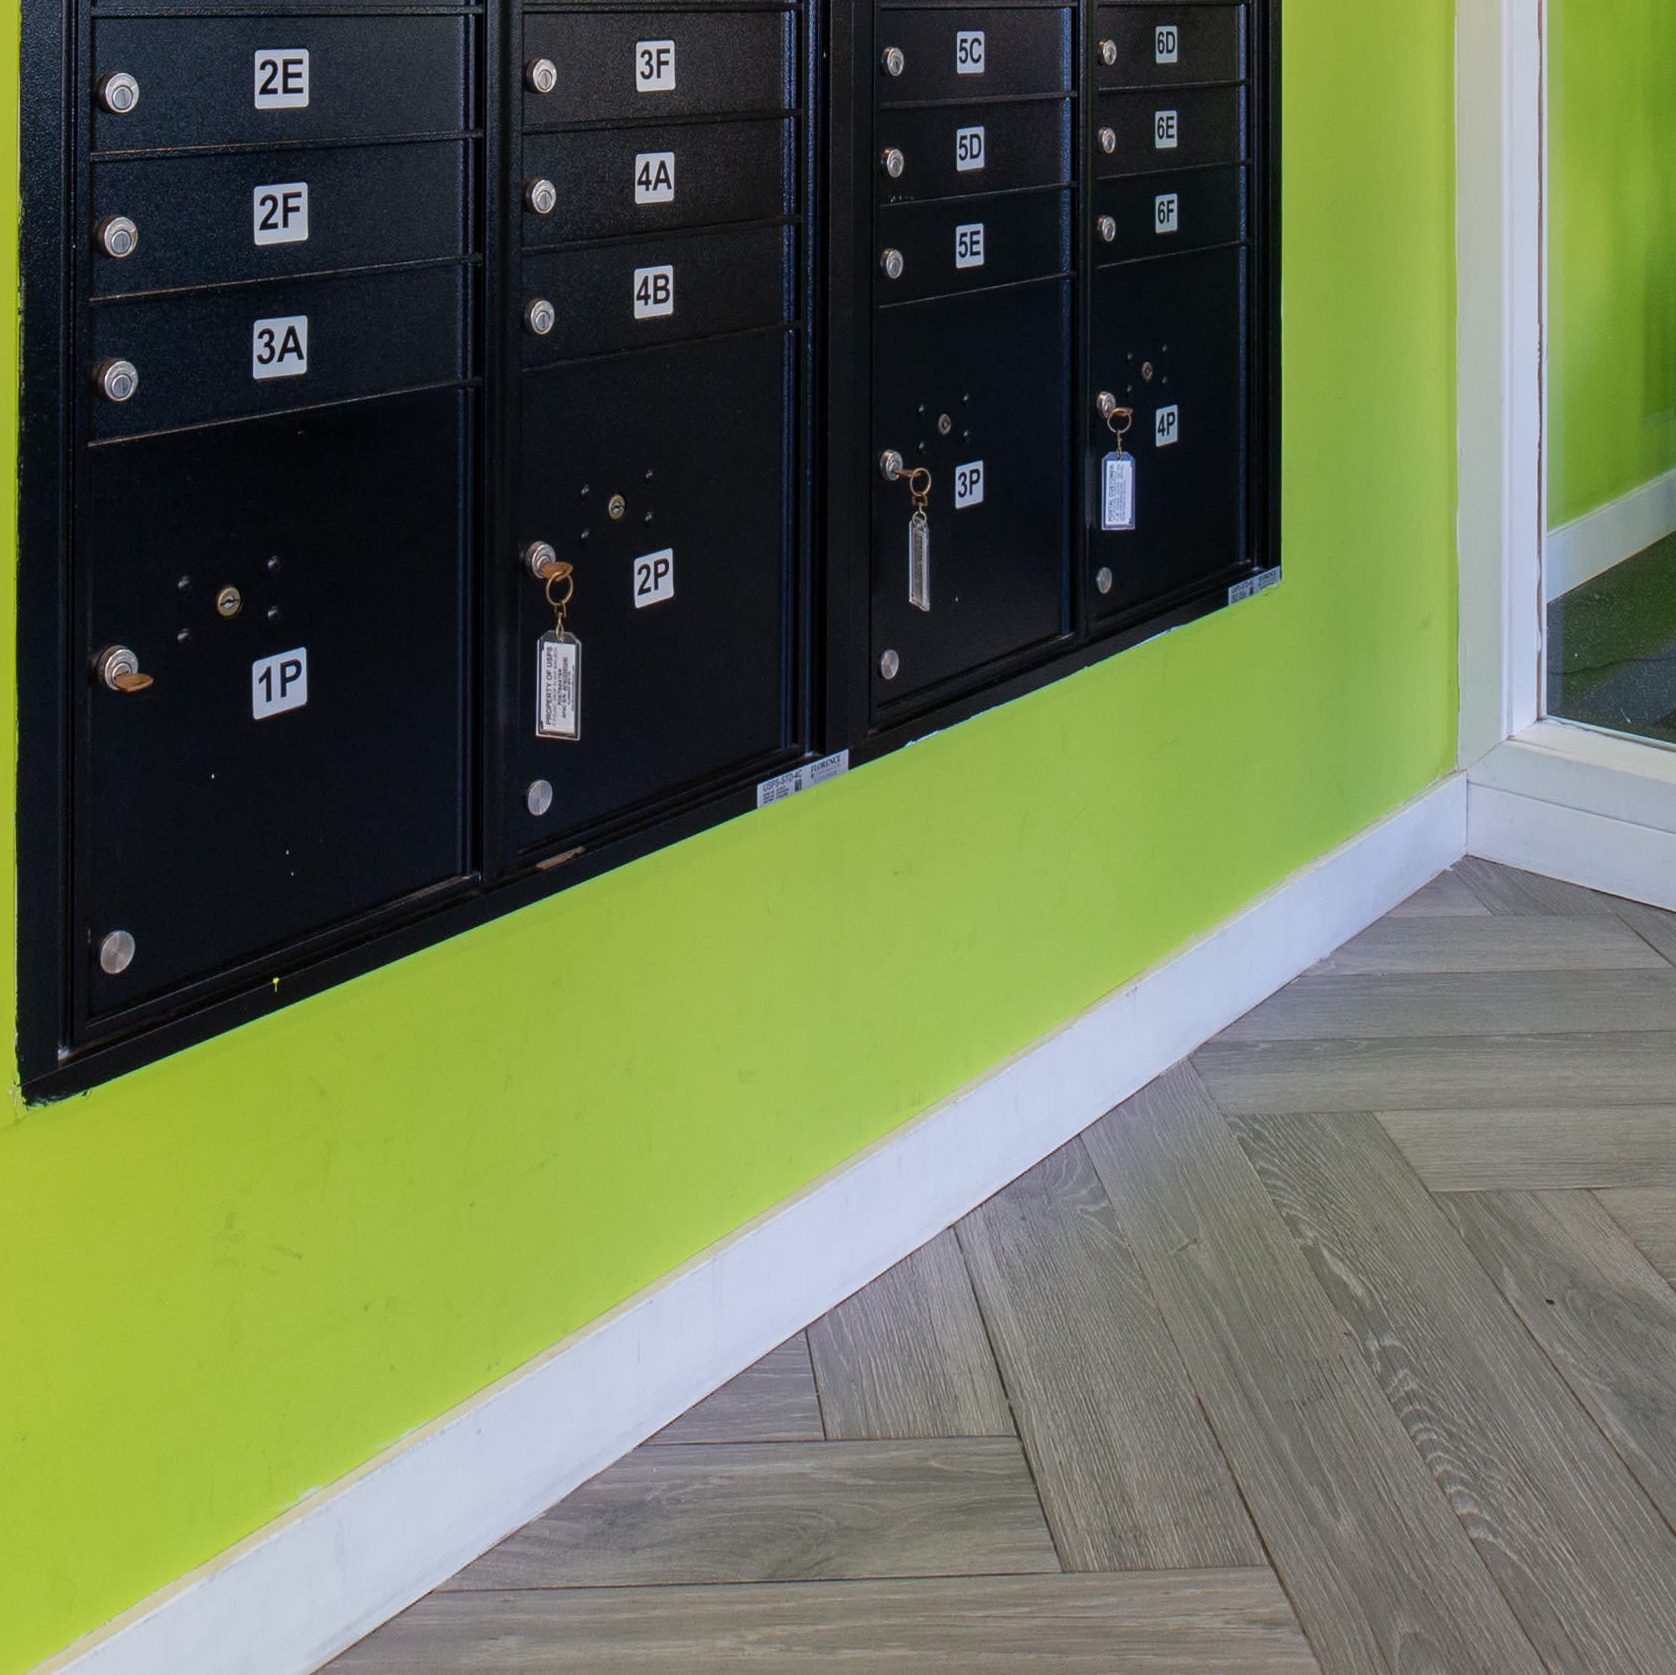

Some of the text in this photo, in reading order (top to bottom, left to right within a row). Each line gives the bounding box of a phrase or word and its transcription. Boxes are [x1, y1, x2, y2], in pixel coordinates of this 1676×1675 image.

[958, 37, 982, 65] 5C
[1157, 31, 1176, 55] 6D
[258, 58, 304, 96] 2E
[640, 48, 671, 80] 3F
[1156, 115, 1175, 140] 6E
[958, 133, 982, 162] 5D
[636, 160, 673, 192] 4A
[258, 191, 303, 231] 2F
[1157, 199, 1175, 225] 6F
[958, 229, 982, 259] 5E
[635, 273, 671, 306] 4B
[256, 325, 305, 365] 3A
[1157, 411, 1176, 437] 4P
[957, 468, 981, 499] 3P
[637, 558, 670, 596] 2P
[258, 659, 302, 703] 1P
[810, 755, 841, 773] FLORENCE
